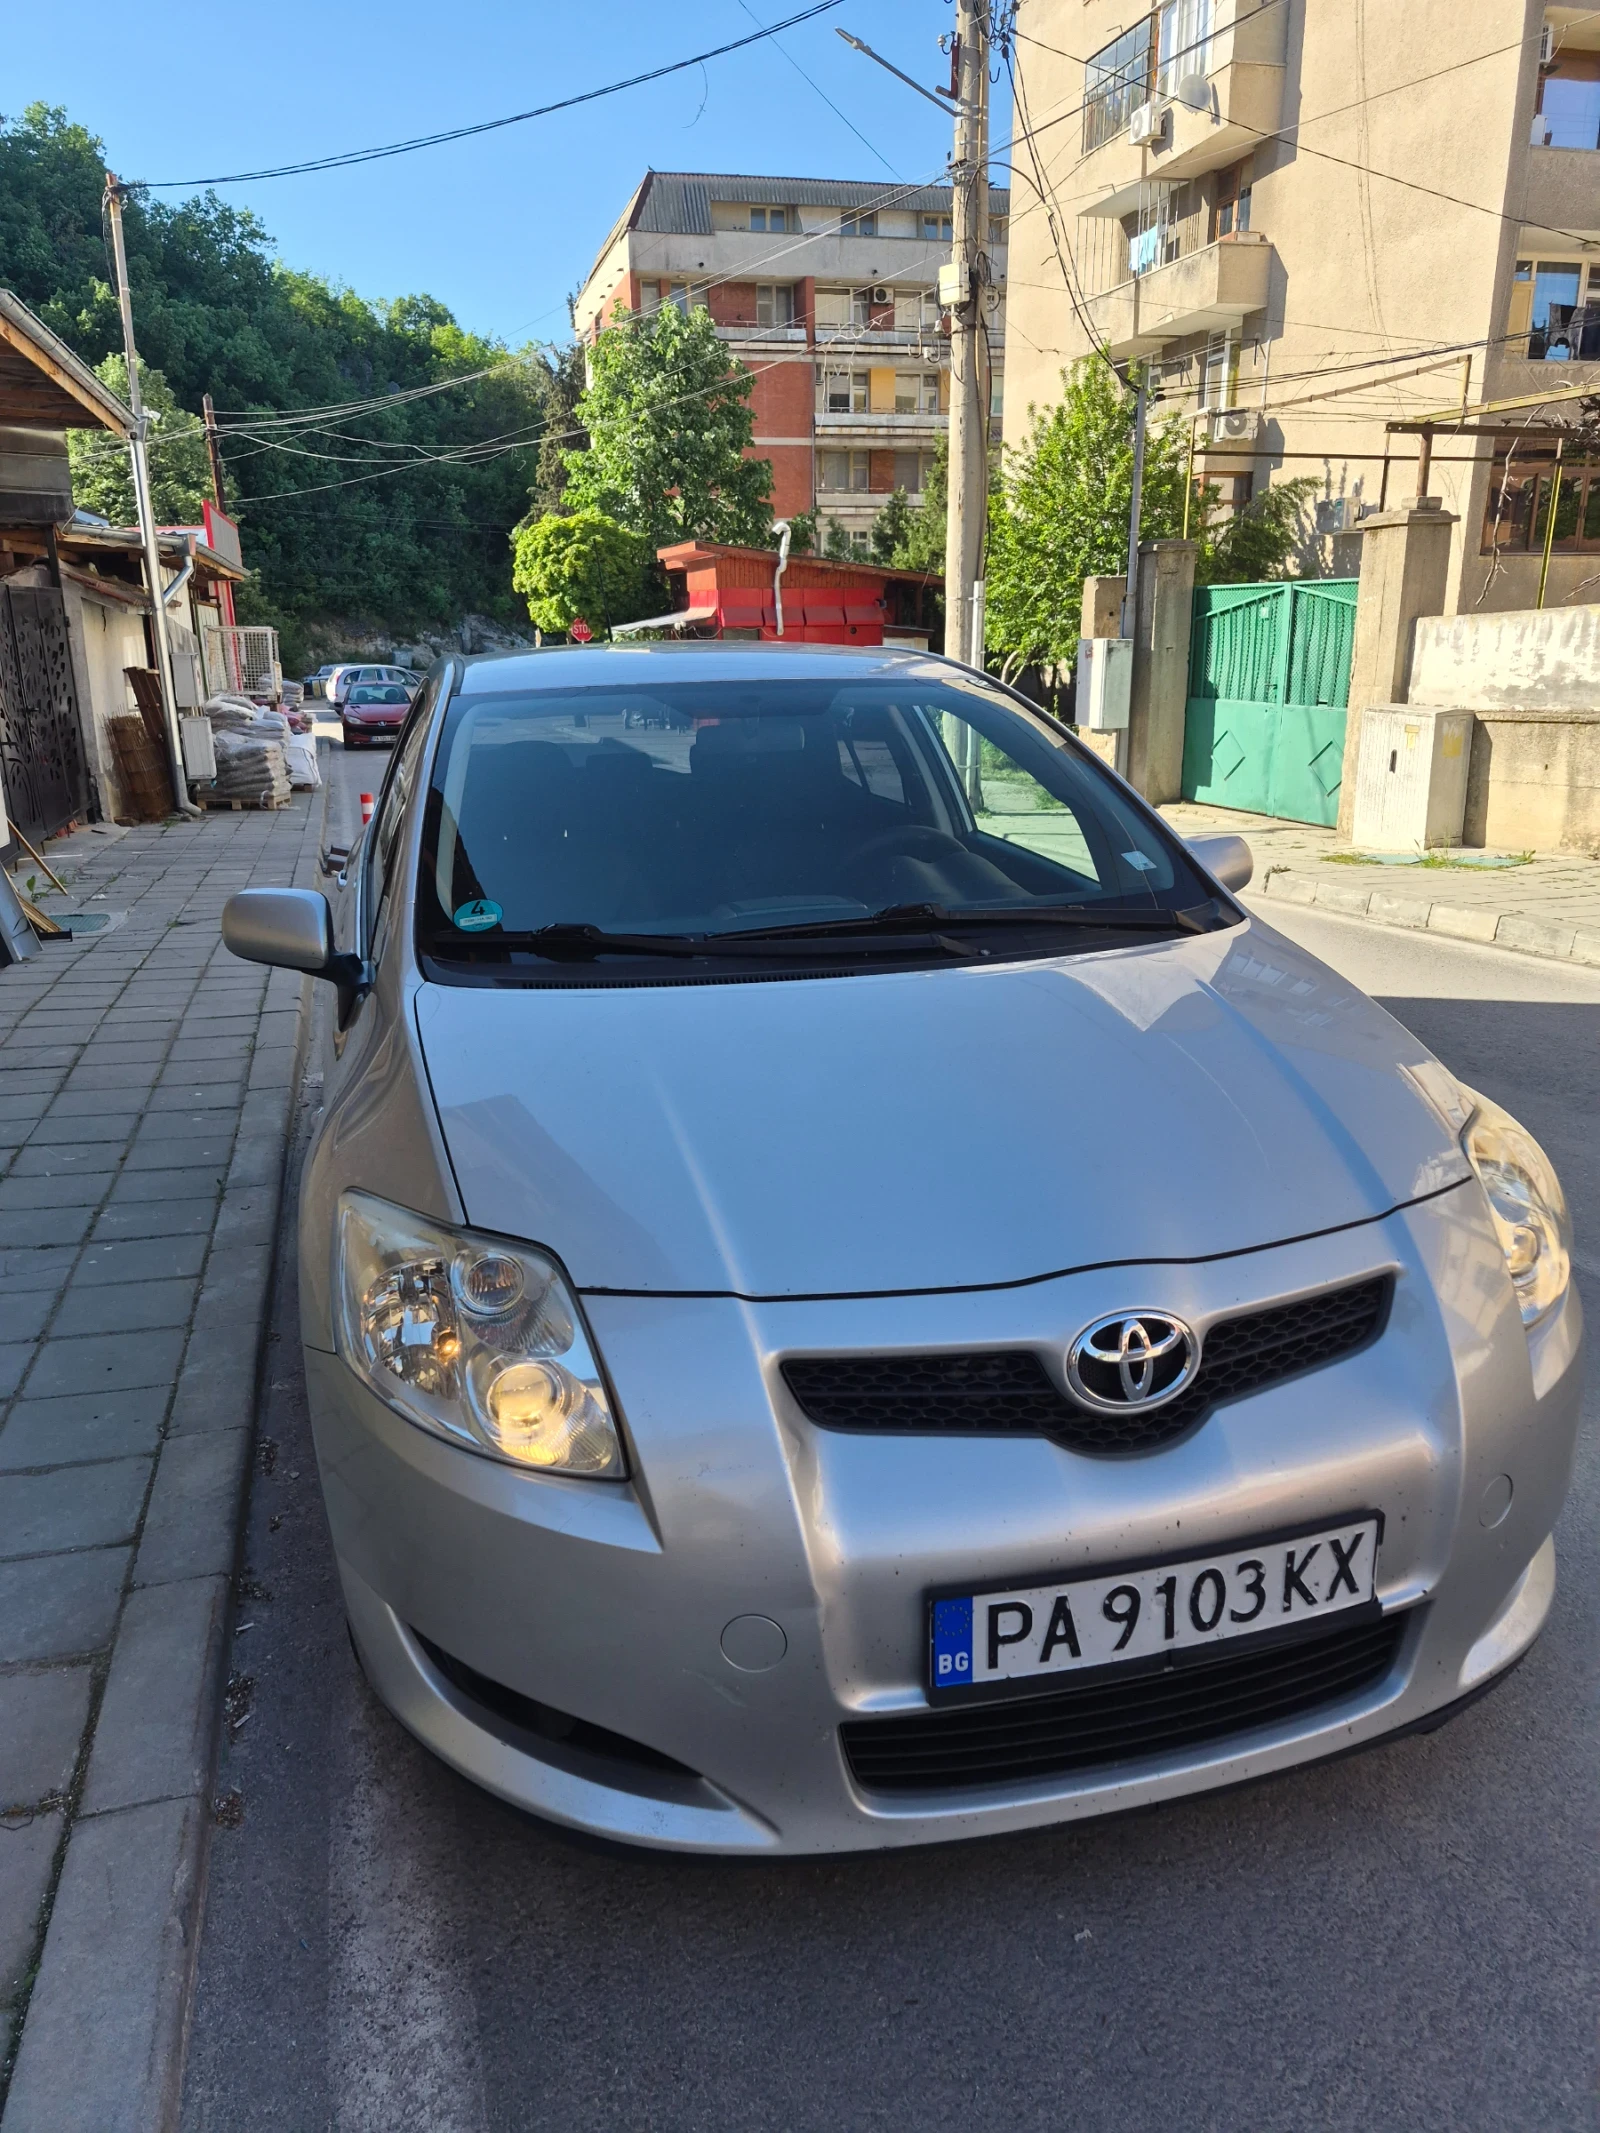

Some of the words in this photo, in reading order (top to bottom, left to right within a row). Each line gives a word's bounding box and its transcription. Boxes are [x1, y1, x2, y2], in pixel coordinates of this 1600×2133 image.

[573, 624, 591, 634] STO
[471, 901, 485, 915] 4
[987, 1594, 1083, 1670] PA
[1102, 1558, 1268, 1652] 9103
[1281, 1531, 1366, 1613] KX
[938, 1652, 969, 1675] BG
